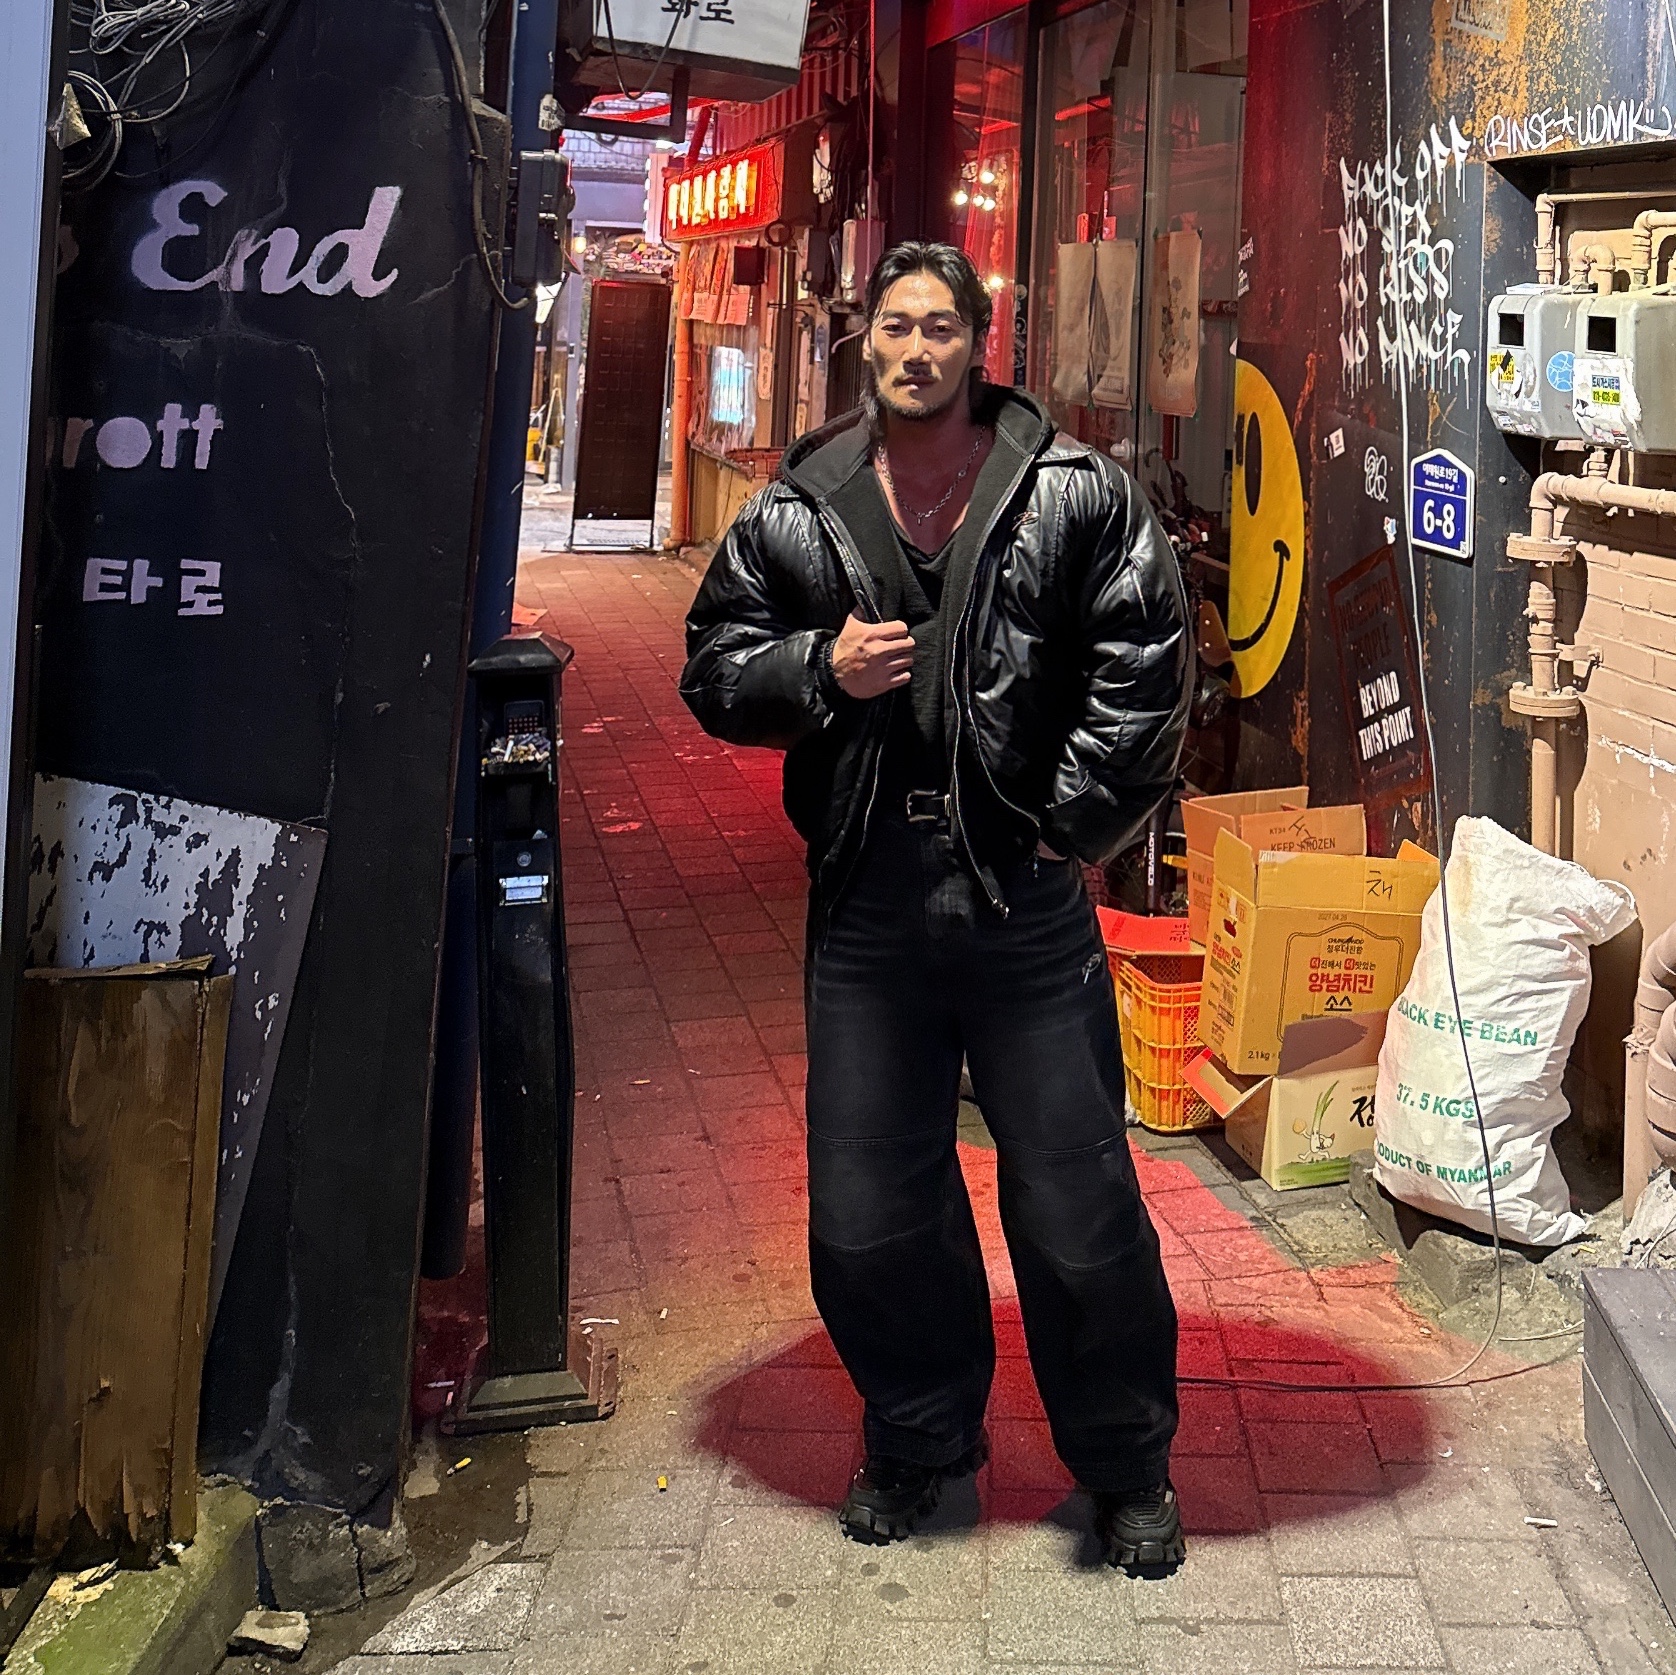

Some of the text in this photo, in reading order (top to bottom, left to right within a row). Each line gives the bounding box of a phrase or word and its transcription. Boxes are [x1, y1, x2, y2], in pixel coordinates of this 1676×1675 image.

[1340, 115, 1471, 209] FUCK OFF
[131, 179, 401, 298] End
[1338, 195, 1432, 259] NO SEX
[1338, 239, 1454, 313] NO KISS
[1338, 325, 1369, 370] NO
[1377, 308, 1471, 371] DANCE
[45, 402, 223, 469] rott
[1423, 499, 1456, 540] 6-8
[1358, 670, 1400, 719] BEYOND
[1358, 705, 1414, 761] THIS POINT
[1147, 831, 1155, 887] MOTOVELO
[1270, 841, 1295, 852] KEEP
[1308, 972, 1375, 994] 양념치킨
[1324, 995, 1353, 1012] 소스
[1434, 1011, 1474, 1037] EYE
[1479, 1022, 1538, 1047] BEAN
[1432, 1095, 1476, 1119] KGS
[1416, 1161, 1432, 1177] OF
